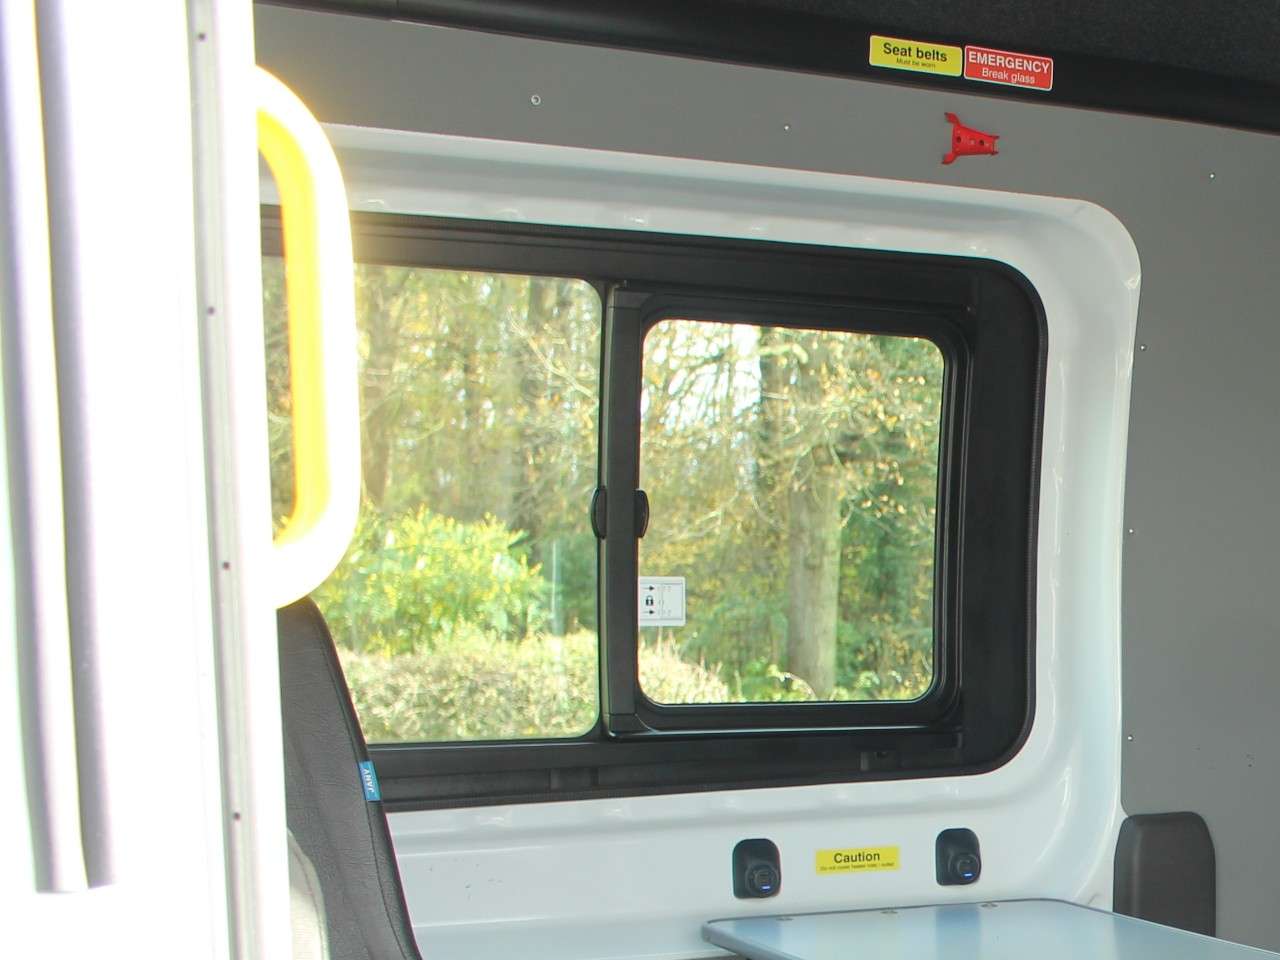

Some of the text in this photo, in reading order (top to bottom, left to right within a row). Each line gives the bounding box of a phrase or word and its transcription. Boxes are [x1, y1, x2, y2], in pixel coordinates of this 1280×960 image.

[883, 42, 948, 62] Seat belts
[968, 50, 1050, 74] EMERGENCY
[982, 67, 1036, 84] Break glass
[833, 852, 880, 863] Caution
